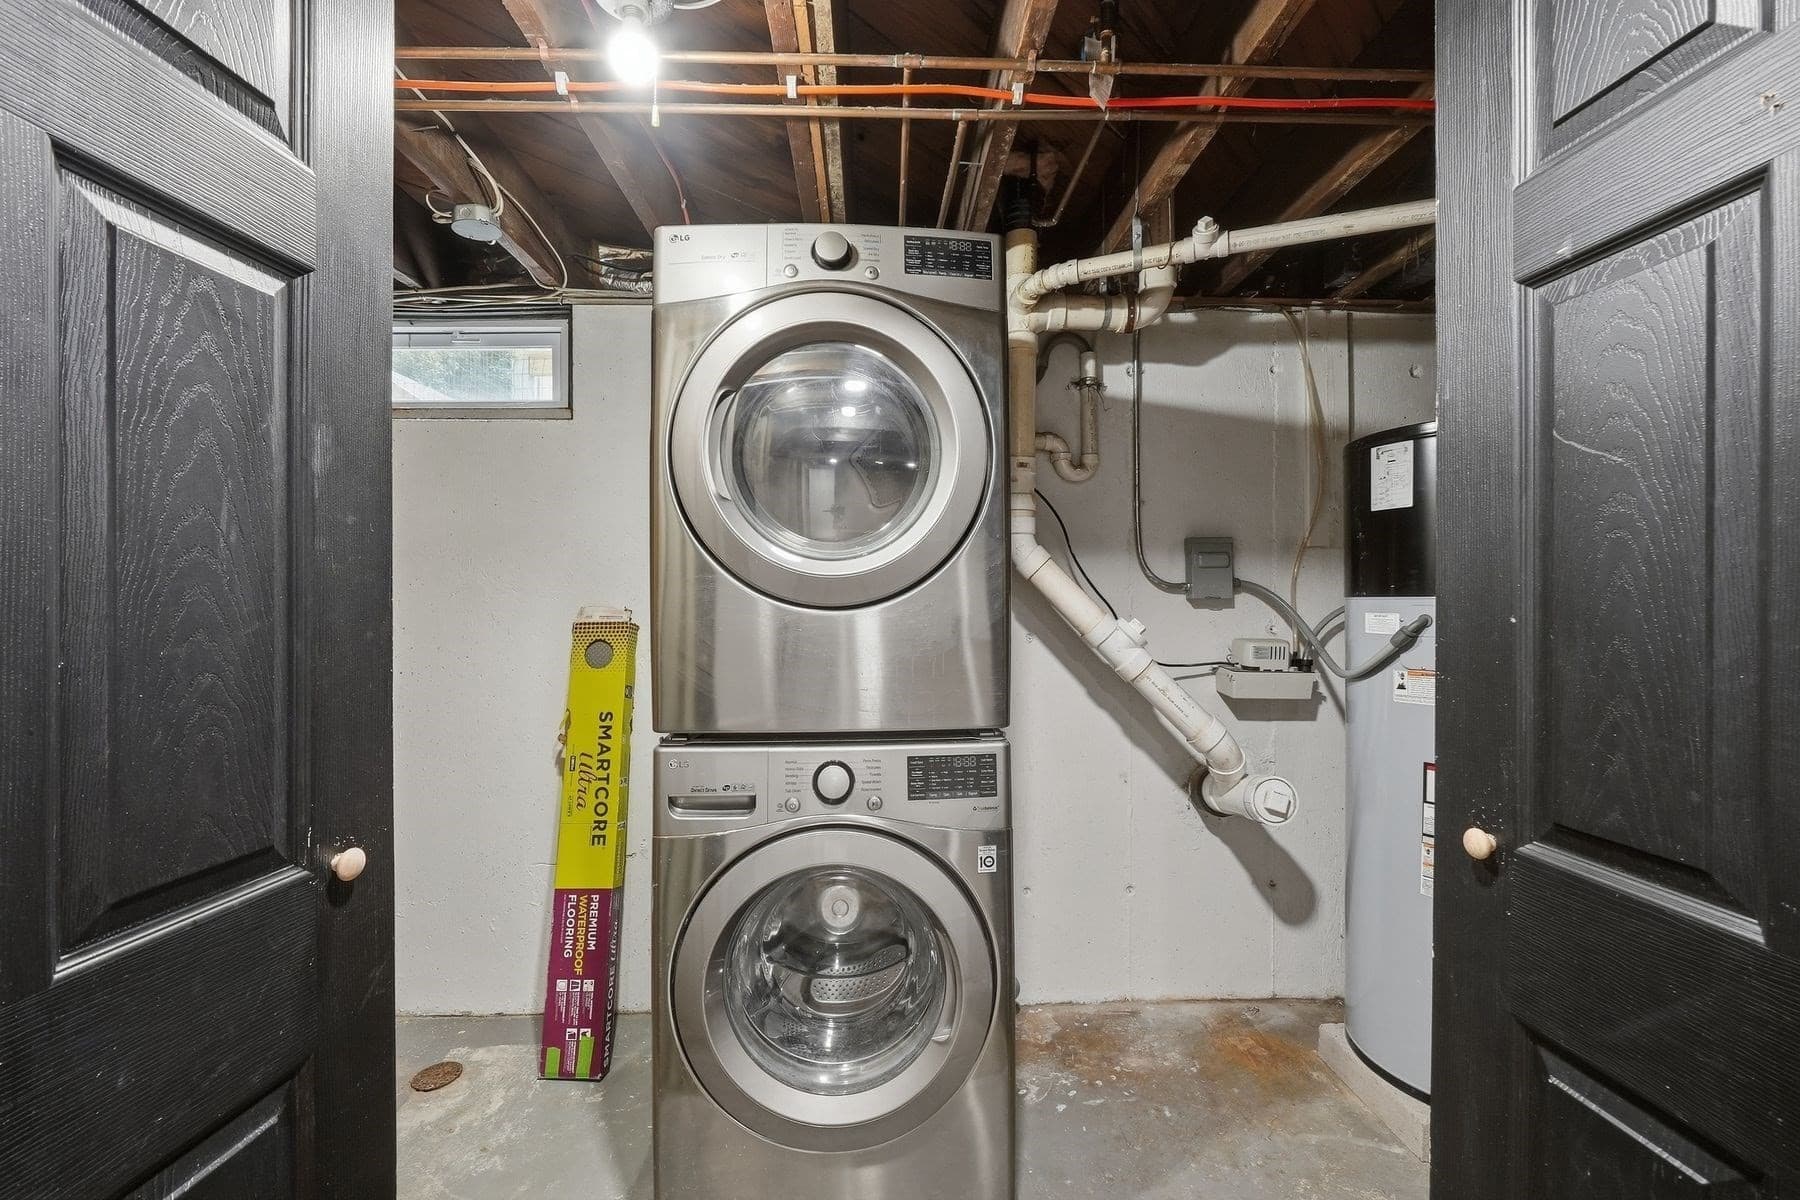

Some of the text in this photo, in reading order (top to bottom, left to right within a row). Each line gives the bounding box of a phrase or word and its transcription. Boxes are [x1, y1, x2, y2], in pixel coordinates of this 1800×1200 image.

[576, 752, 598, 811] Ultra
[591, 711, 613, 846] SMARTCORE
[563, 894, 577, 958] FLOORING
[573, 895, 589, 976] WATERPROOF
[587, 894, 600, 951] PREMIUM
[610, 920, 619, 962] Ultra
[603, 964, 616, 1069] SMARTCORE
